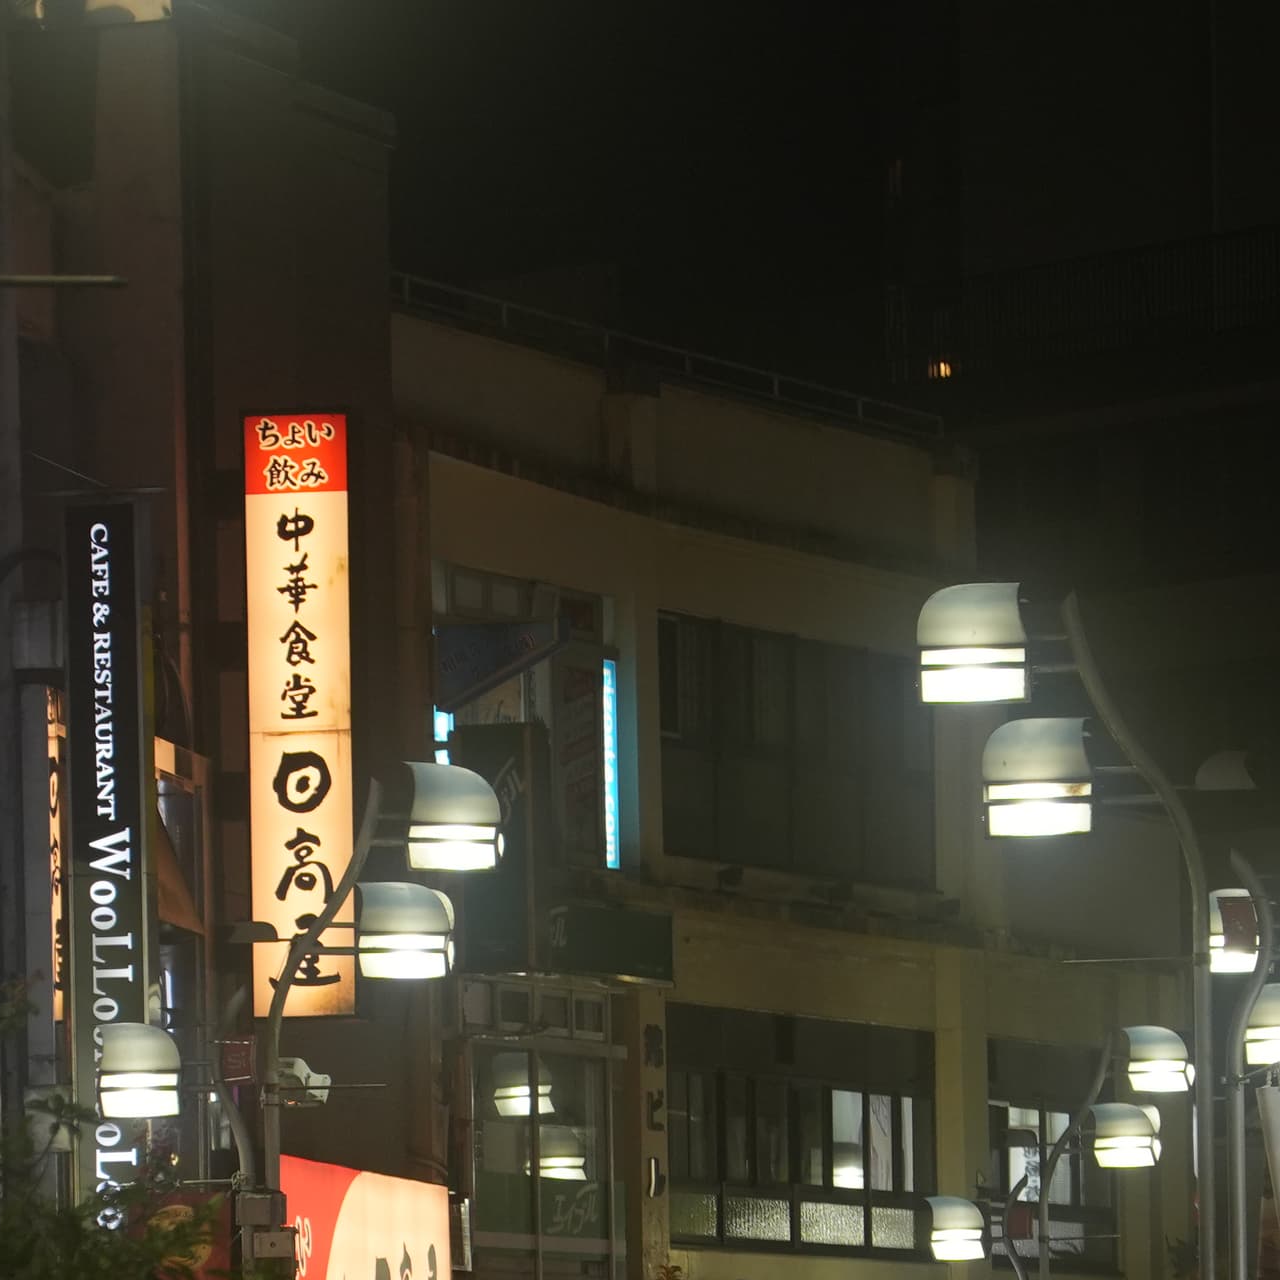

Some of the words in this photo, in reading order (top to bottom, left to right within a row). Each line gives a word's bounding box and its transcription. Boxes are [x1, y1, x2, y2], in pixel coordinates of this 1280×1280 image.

[257, 420, 335, 449] ちょい
[265, 457, 327, 489] 飲み
[89, 522, 111, 596] CAFE
[92, 601, 111, 626] &
[276, 508, 319, 721] 中華食堂
[93, 631, 117, 821] RESTAURANT
[269, 751, 342, 989] 日高屋
